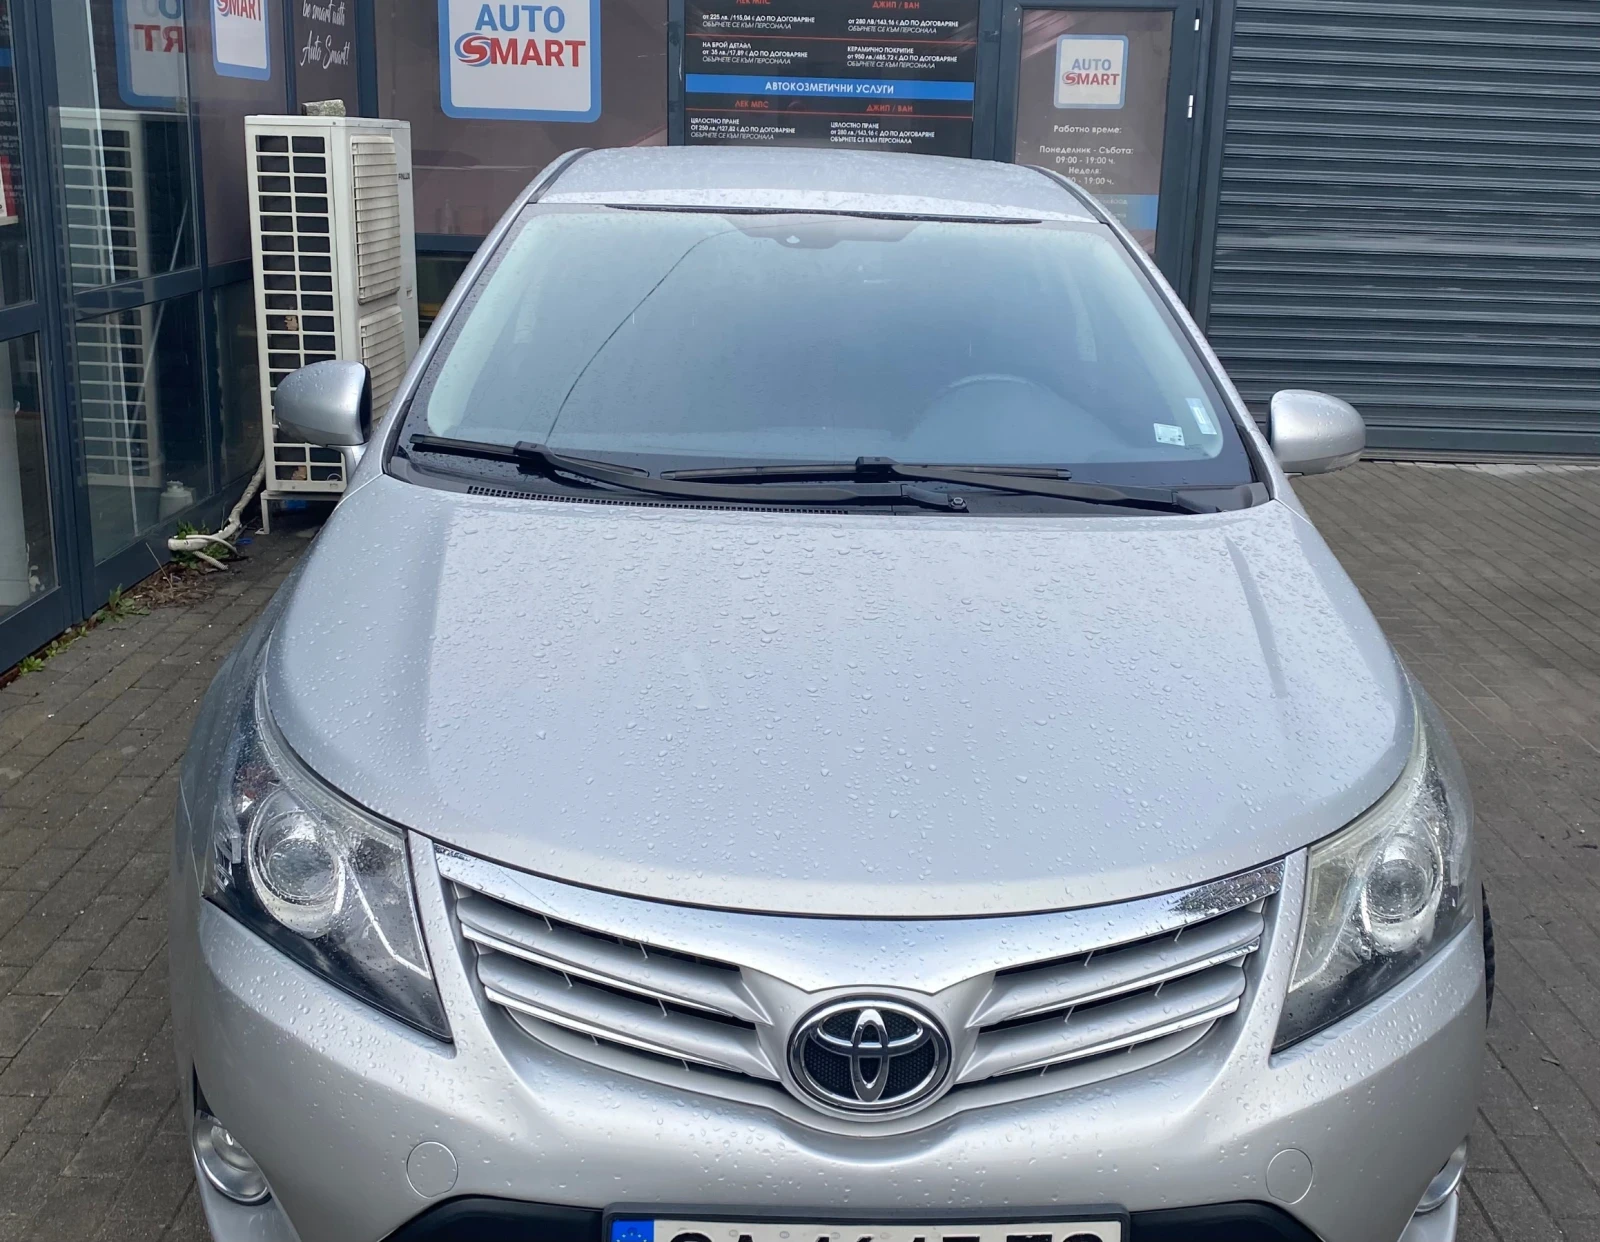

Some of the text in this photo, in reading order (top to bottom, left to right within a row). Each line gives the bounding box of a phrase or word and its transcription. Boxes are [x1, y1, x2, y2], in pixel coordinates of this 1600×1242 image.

[302, 0, 311, 18] be
[312, 0, 335, 23] smart
[474, 4, 565, 33] AUTO
[300, 30, 350, 69] Auto Smart!
[454, 32, 586, 67] SMART
[1071, 58, 1112, 71] AUTO
[1062, 71, 1120, 86] SMART
[765, 82, 894, 94] АВТОКОЗМЕТИЧНИ УСЛУГИ
[866, 104, 890, 112] ДЖИП
[898, 105, 913, 113] ВАН
[1053, 124, 1122, 134] Работно време:
[1040, 145, 1091, 154] Понеделник
[1098, 146, 1134, 154] Събота:
[1086, 156, 1107, 164] 19:00
[1068, 166, 1102, 175] Неделя:
